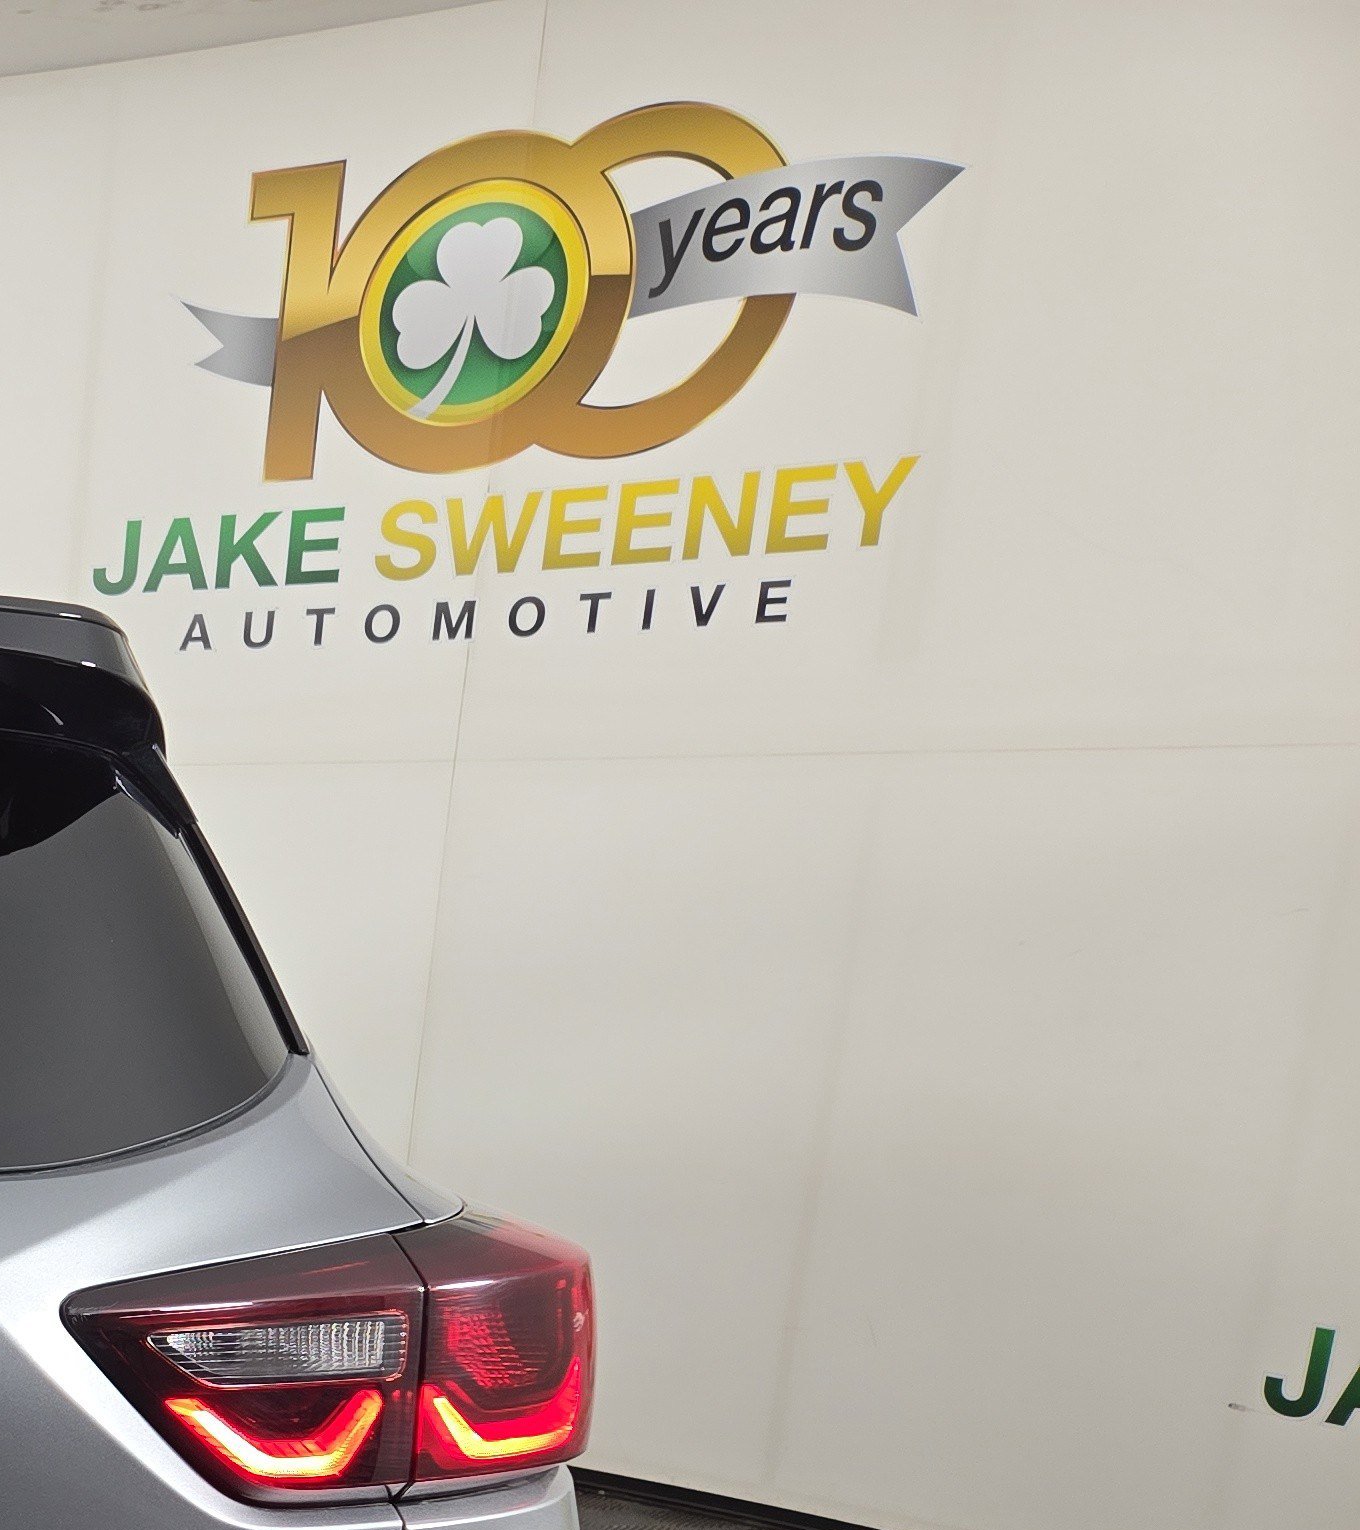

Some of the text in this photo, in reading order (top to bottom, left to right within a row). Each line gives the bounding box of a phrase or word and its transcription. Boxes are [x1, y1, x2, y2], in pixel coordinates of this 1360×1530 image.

[250, 100, 884, 484] 100 years
[92, 454, 922, 596] JAKE SWEENEY
[178, 578, 794, 652] AUTOMOTIVE
